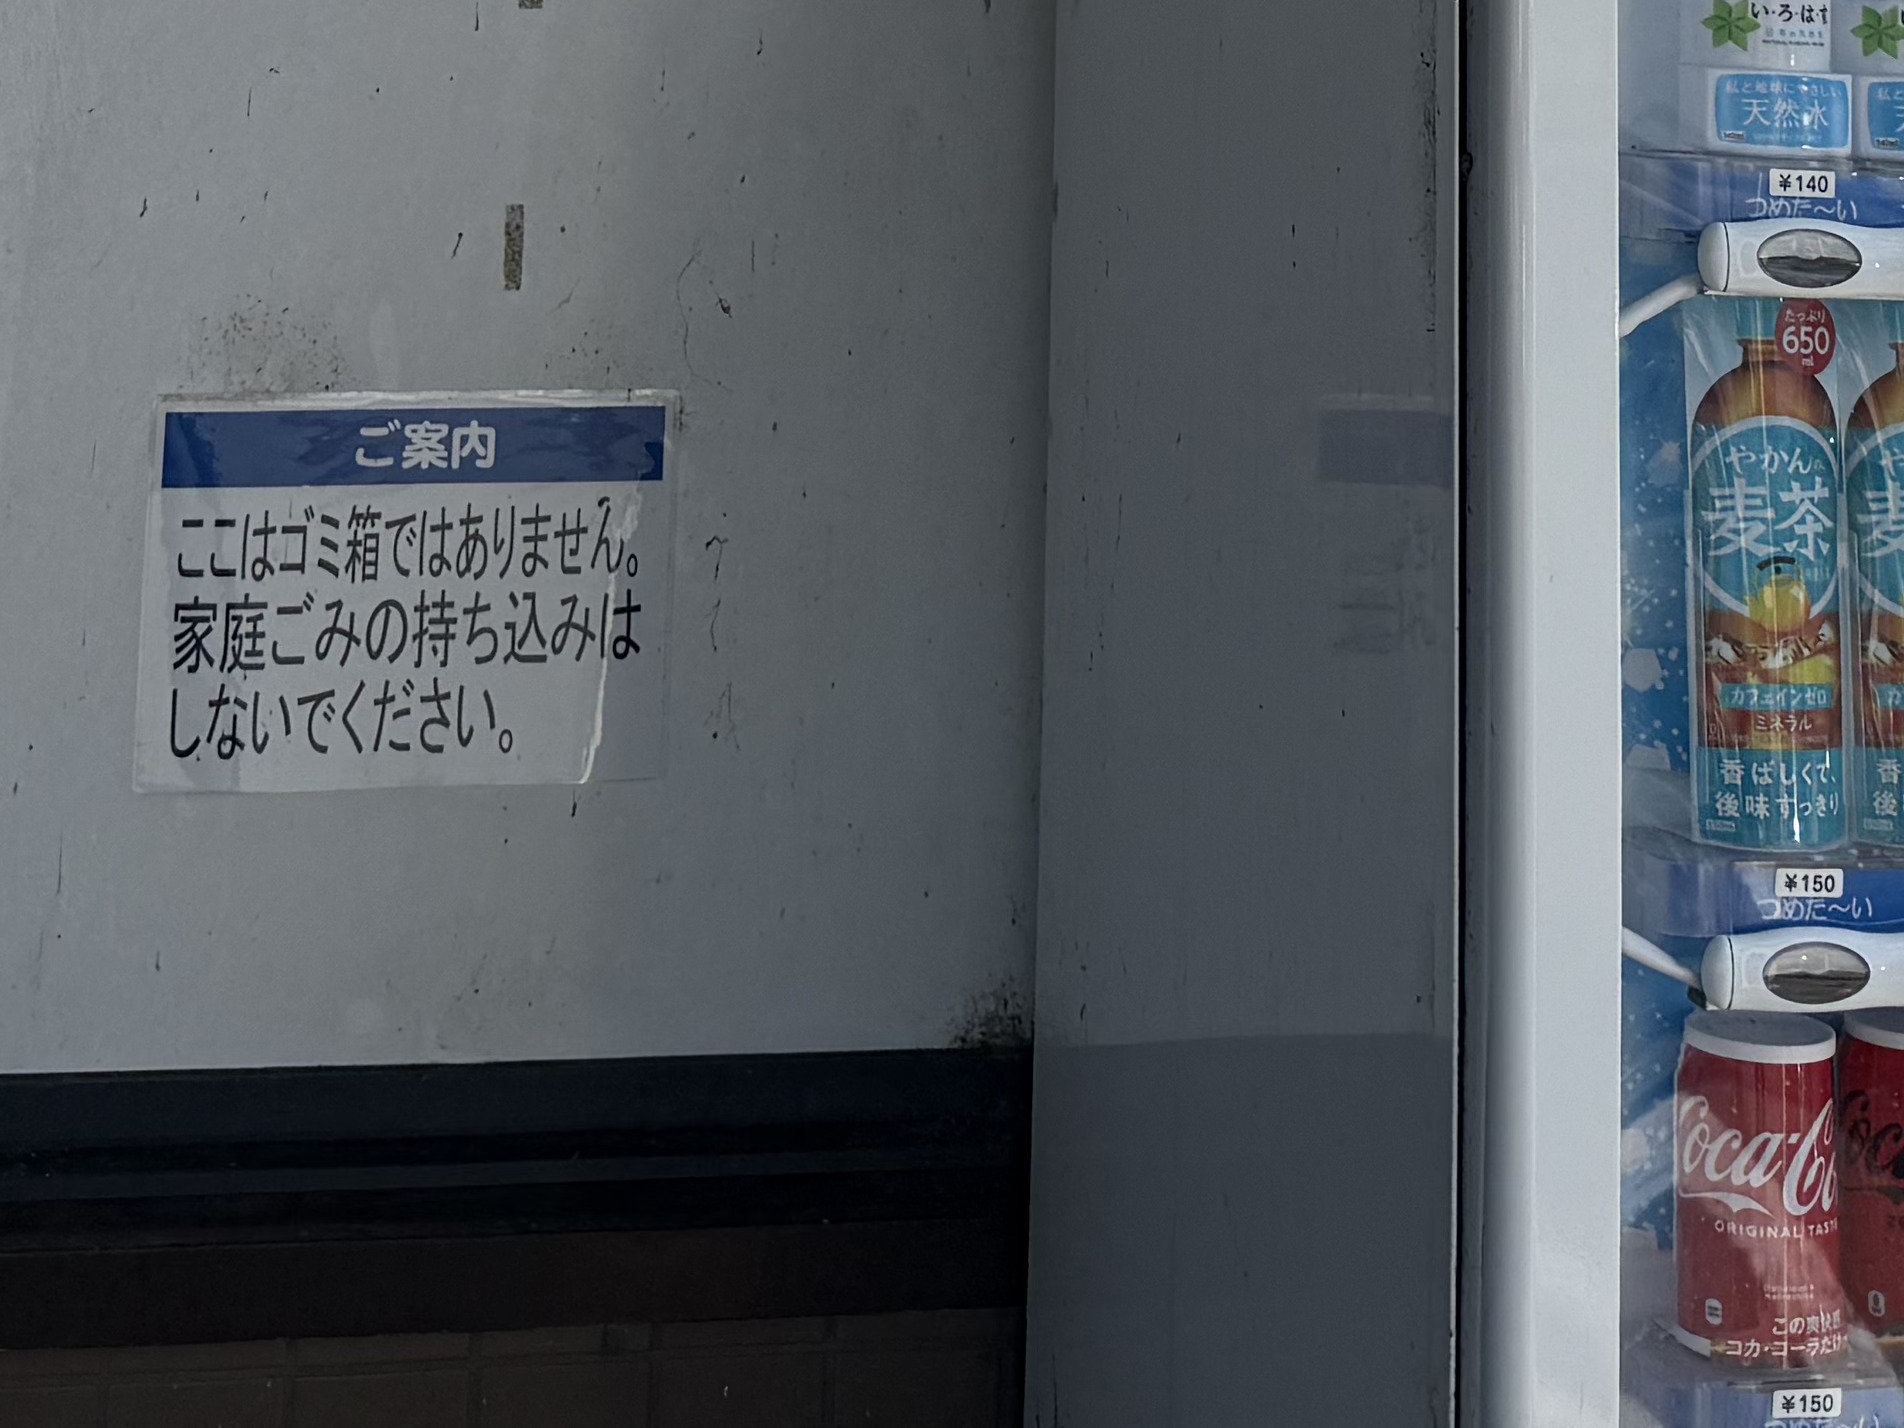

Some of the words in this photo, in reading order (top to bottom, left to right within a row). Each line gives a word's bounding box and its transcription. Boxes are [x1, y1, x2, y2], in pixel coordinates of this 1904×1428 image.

[1742, 99, 1830, 129] 天然水
[1779, 174, 1828, 193] ¥140
[1784, 308, 1825, 323] たっぷり
[1782, 326, 1830, 355] 650
[354, 419, 497, 470] ご案内
[1701, 477, 1834, 561] 麦茶
[177, 496, 638, 582] ここはゴミ箱ではありません。
[172, 589, 641, 674] 家庭ごみの持ち込みは
[169, 677, 513, 759] しないでください。
[1755, 715, 1812, 731] ミネラル
[1719, 759, 1836, 786] 香ばしくて、
[1784, 873, 1835, 893] ¥150
[1714, 1219, 1804, 1239] ORIGINAL
[1782, 1394, 1834, 1413] ¥150
